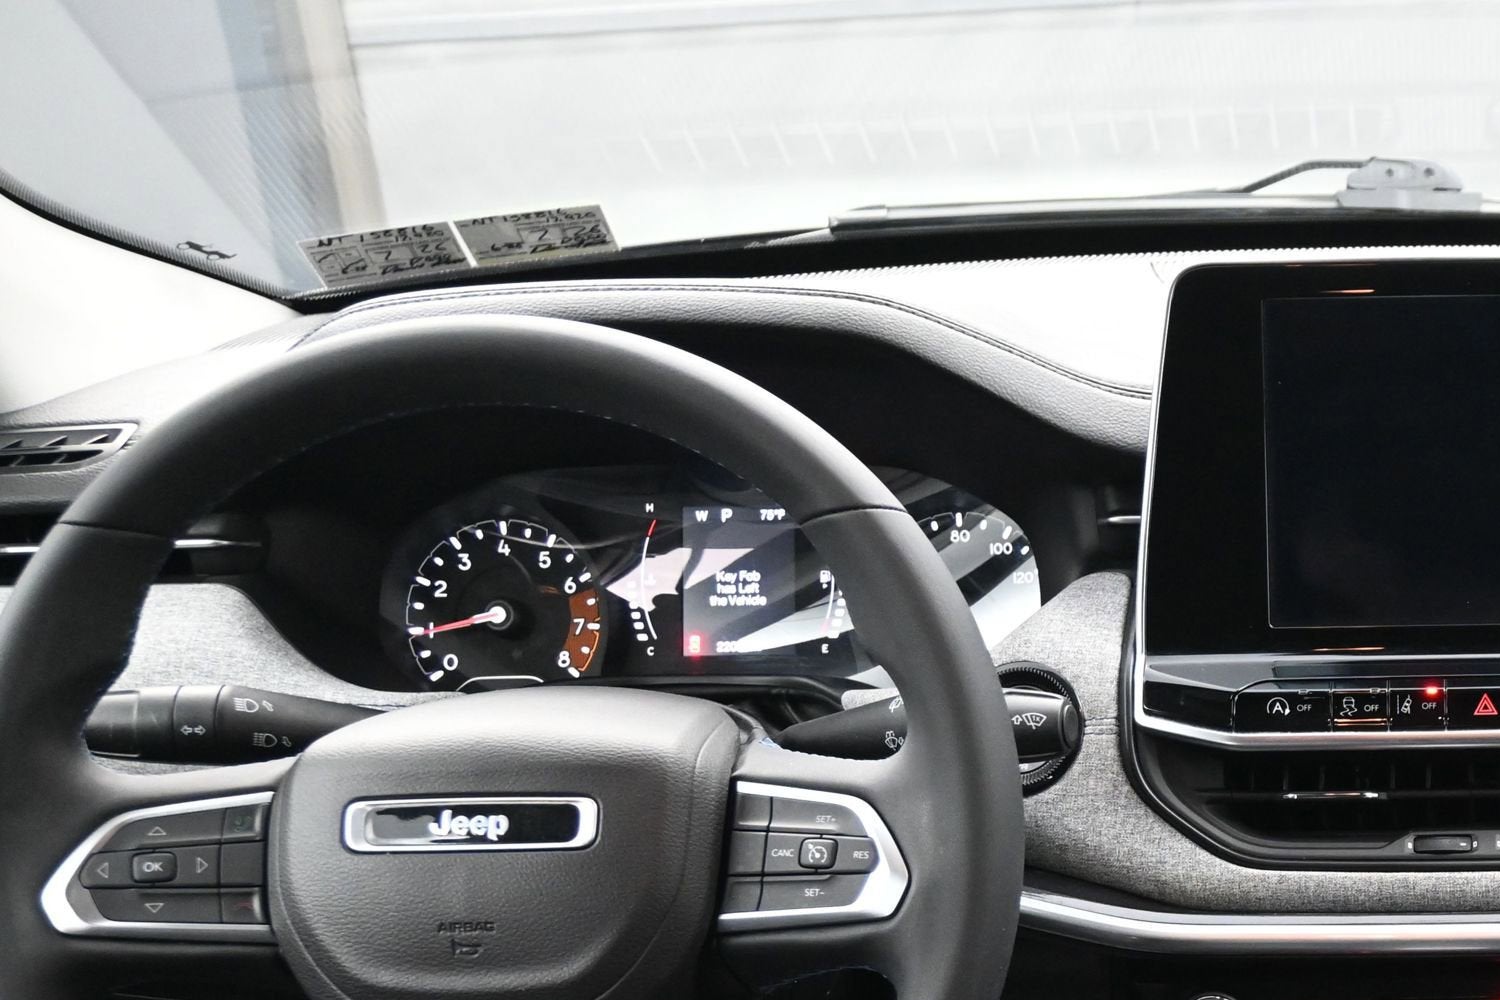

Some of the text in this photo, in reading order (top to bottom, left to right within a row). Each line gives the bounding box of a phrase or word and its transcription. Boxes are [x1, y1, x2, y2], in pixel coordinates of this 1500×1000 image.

[646, 503, 654, 513] H
[695, 510, 708, 522] W
[721, 508, 733, 523] P
[950, 529, 970, 542] 80
[498, 540, 510, 556] 4
[989, 542, 1013, 555] 100
[458, 553, 471, 571] 3
[539, 552, 551, 569] 5
[1012, 571, 1034, 584] 120
[434, 580, 448, 597] 2
[564, 577, 576, 593] 6
[573, 618, 585, 635] 7
[647, 646, 655, 656] C
[821, 643, 829, 654] E
[442, 654, 459, 671] 0
[558, 651, 571, 668] 8
[1297, 703, 1312, 713] OFF
[1363, 703, 1379, 713] OFF
[1421, 701, 1437, 711] OFF
[428, 809, 510, 841] Jeep
[771, 848, 795, 858] CANC
[852, 850, 870, 860] RES
[142, 861, 163, 873] OK
[436, 920, 496, 934] AIRBAG
